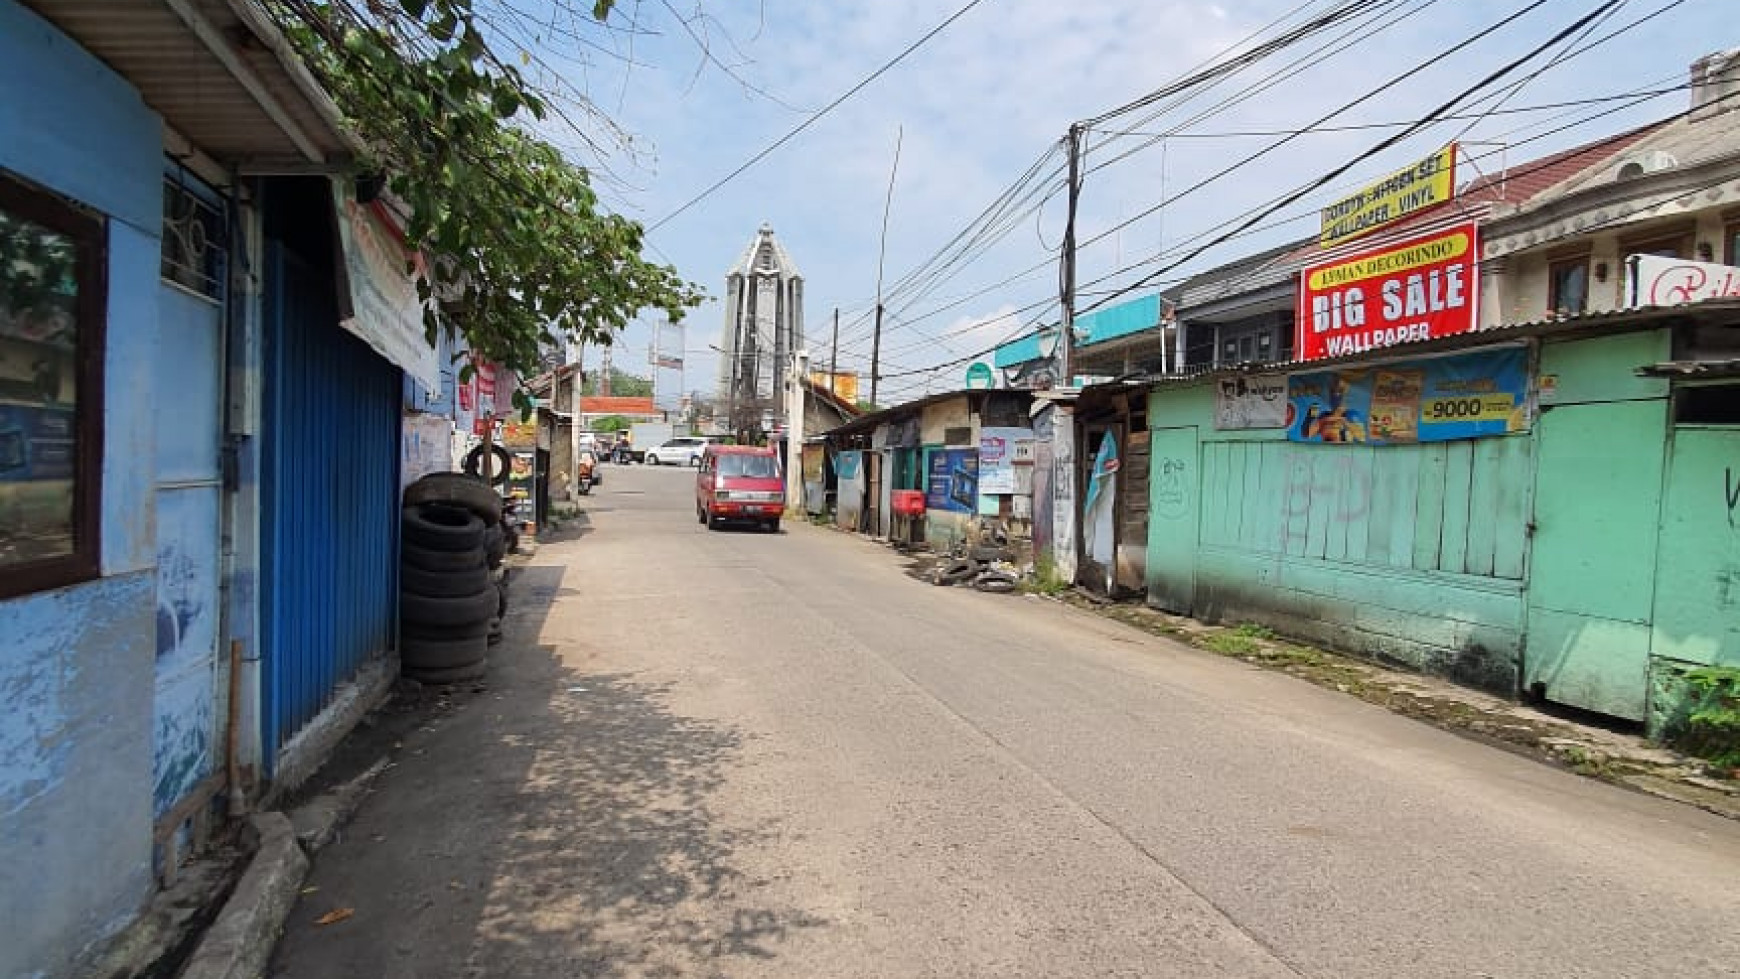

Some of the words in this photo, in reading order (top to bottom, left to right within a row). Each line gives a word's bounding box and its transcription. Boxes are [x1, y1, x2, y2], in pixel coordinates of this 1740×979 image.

[1418, 153, 1443, 180] SET
[1399, 185, 1435, 213] VINYL
[1322, 264, 1363, 285] LYMAN
[1367, 241, 1454, 274] DECORINDO
[1312, 287, 1366, 333] BIG
[1382, 263, 1465, 321] SALE
[1327, 322, 1430, 357] WALLPAPER
[1433, 398, 1481, 418] 9000
